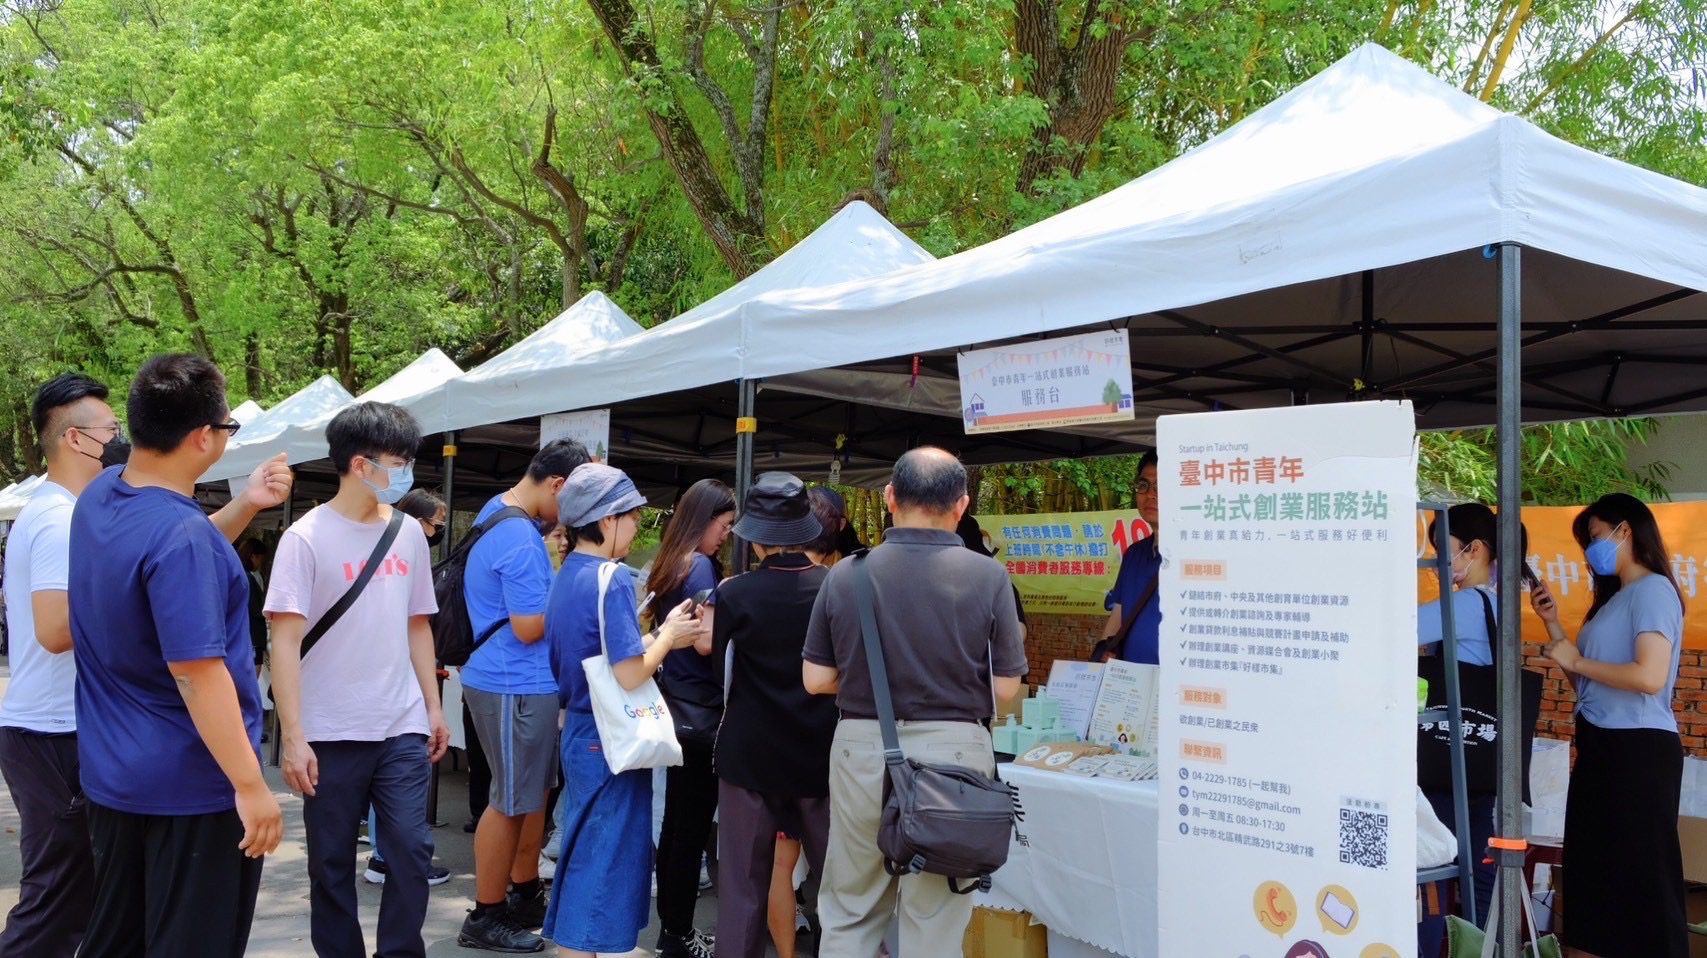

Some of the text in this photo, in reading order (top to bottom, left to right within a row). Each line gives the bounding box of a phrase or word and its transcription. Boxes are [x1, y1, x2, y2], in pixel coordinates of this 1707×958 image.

[1021, 386, 1060, 407] 服務台
[1179, 442, 1249, 455] Startup in Taichung
[1179, 456, 1304, 487] 臺中市青年
[1180, 490, 1389, 521] 一站式創業服務站
[1184, 564, 1222, 576] 服務項目
[1184, 690, 1222, 704] 服務對象
[623, 702, 665, 720] Google
[1192, 770, 1291, 796] 04-2229-1785 (一起幫我)
[1192, 789, 1302, 815] tym22291785@gmail.com
[1192, 807, 1286, 832] 周一至周五 08:30-17:30
[1192, 825, 1315, 858] 台中市北區精武路291之3號7樓
